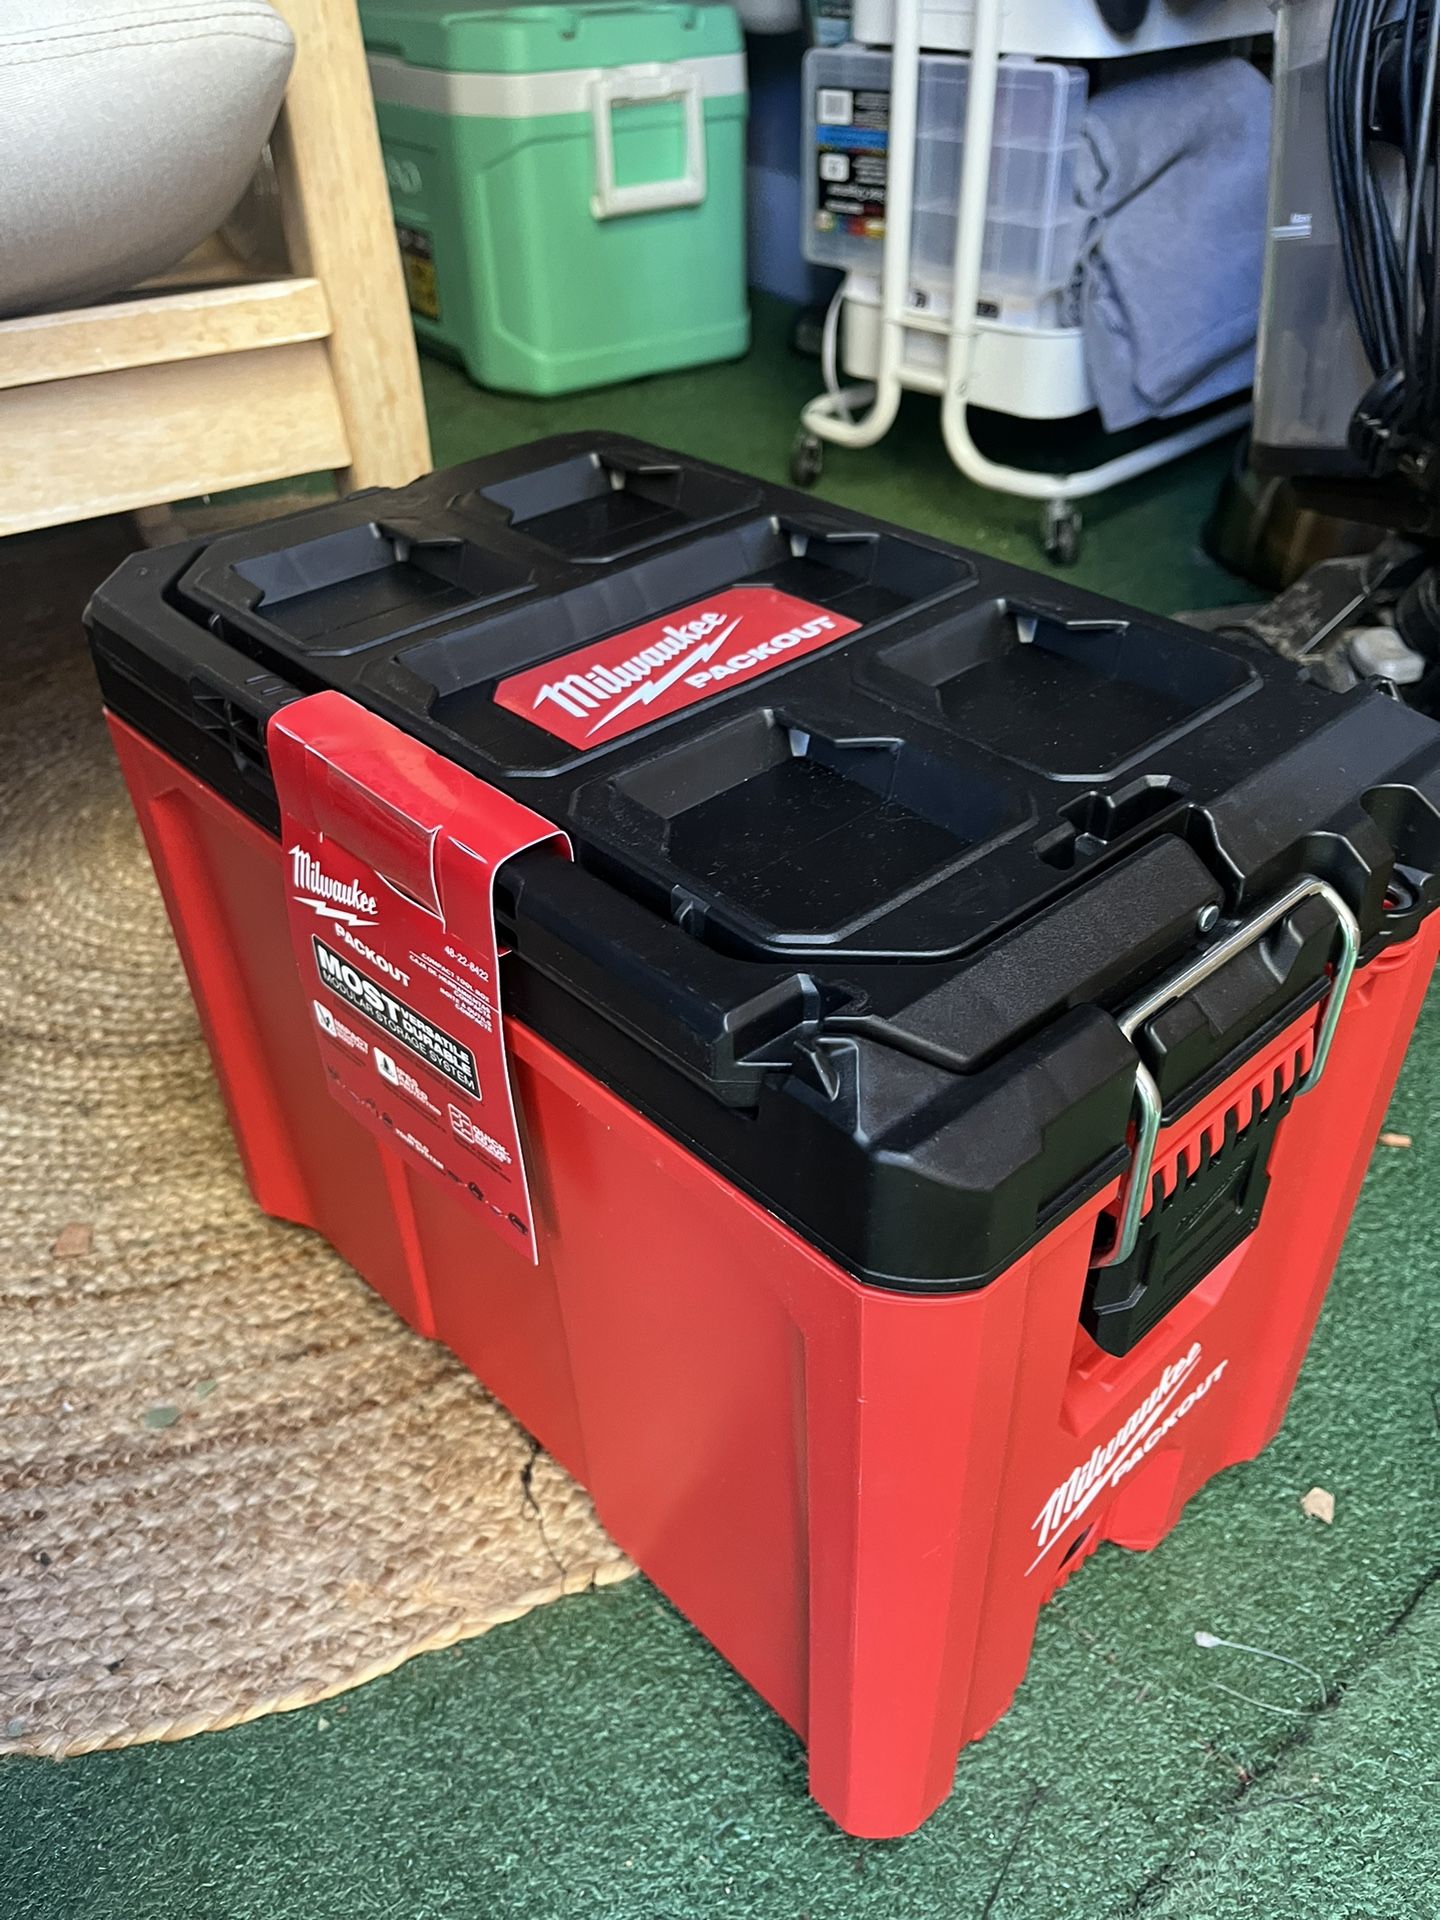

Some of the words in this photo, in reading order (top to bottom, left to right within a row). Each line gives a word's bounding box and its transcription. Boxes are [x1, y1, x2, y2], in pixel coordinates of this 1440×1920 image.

[533, 612, 727, 717] Milwaukee
[684, 615, 837, 689] PACKOUT
[288, 844, 378, 915] Milwaukee
[317, 944, 401, 1023] MOST
[334, 922, 410, 987] PACKOUT
[322, 969, 375, 1015] MODULAR
[375, 1010, 428, 1055] STORAGE
[428, 1049, 475, 1090] SYSTEM
[400, 1007, 470, 1065] VERSATILE
[402, 1018, 473, 1078] DURABLE
[1031, 1342, 1202, 1547] Milwaukee
[1111, 1359, 1229, 1487] PACKOUT
